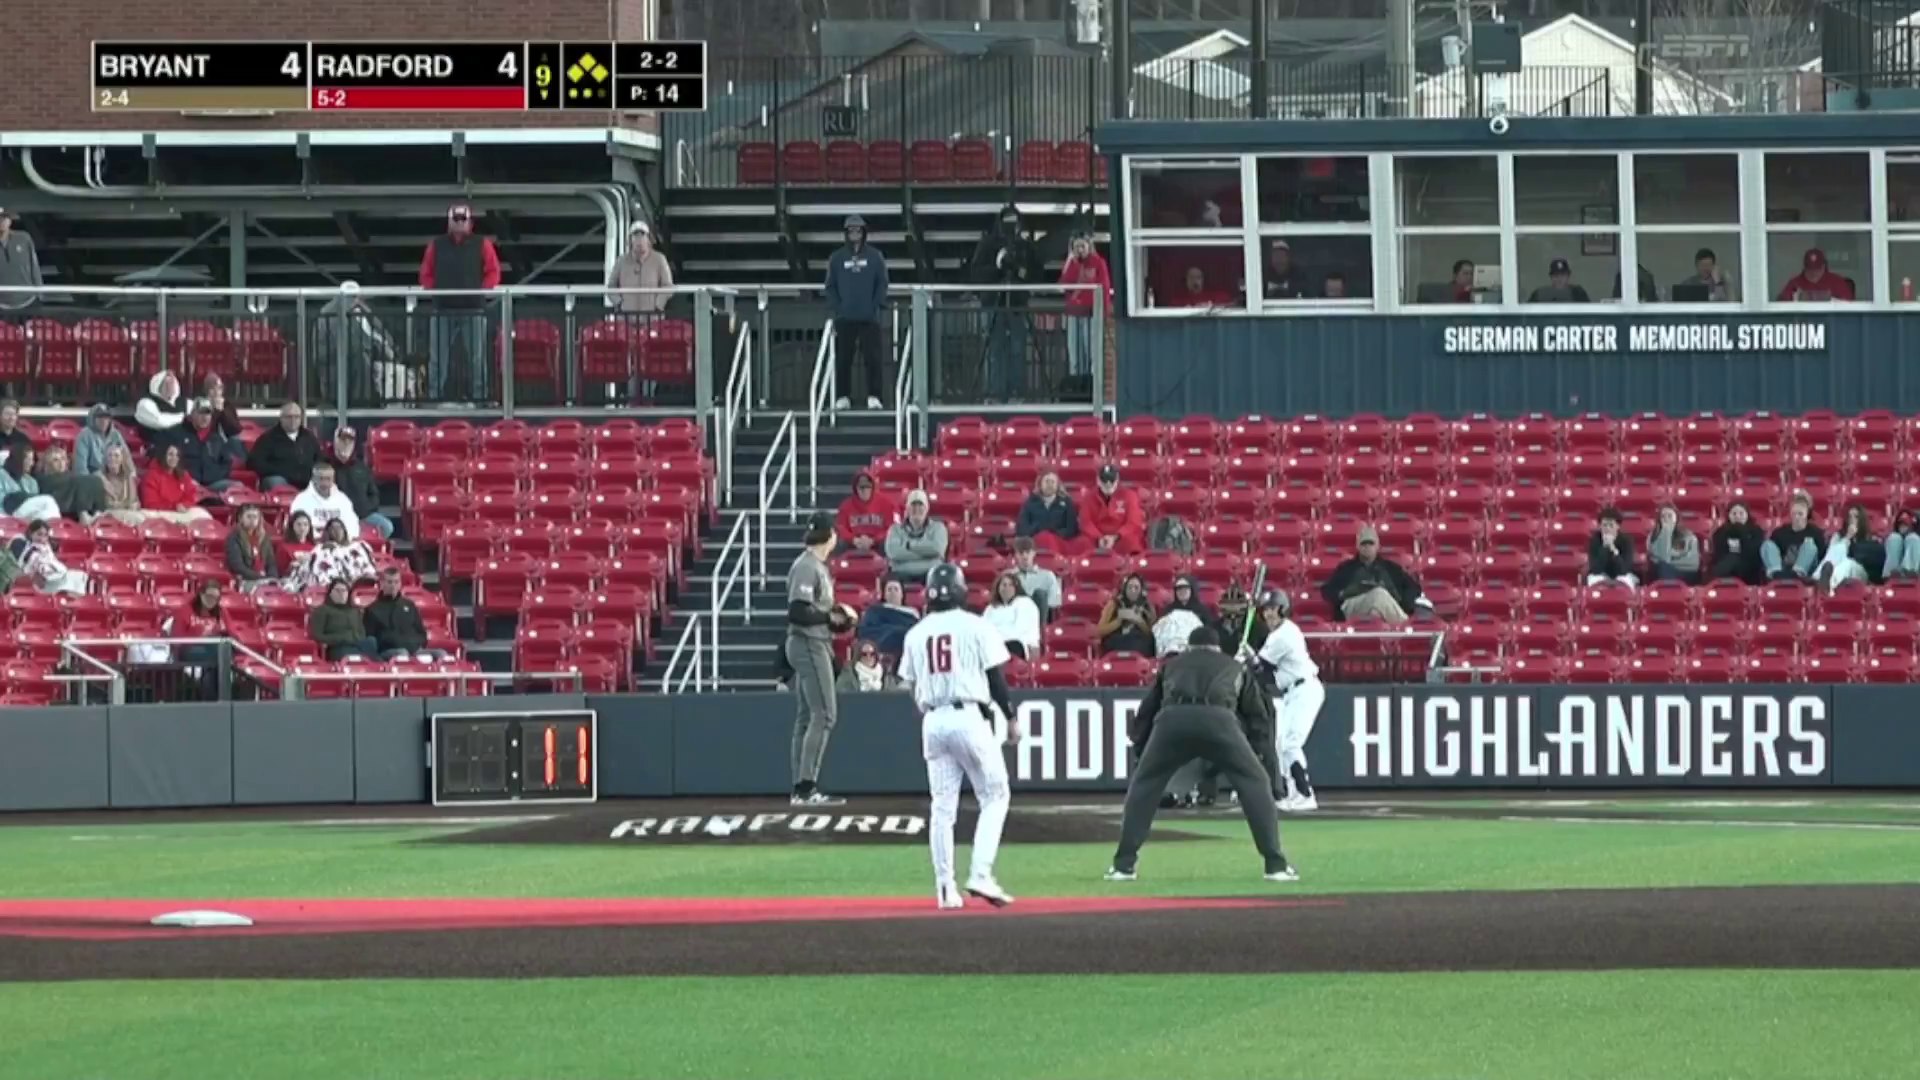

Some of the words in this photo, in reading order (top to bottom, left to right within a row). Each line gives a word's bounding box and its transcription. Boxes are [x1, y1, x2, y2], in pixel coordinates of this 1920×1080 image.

[824, 111, 855, 132] RU
[1443, 325, 1539, 353] SHERMAN
[1543, 325, 1618, 352] CARTER
[1629, 324, 1734, 352] MEMORIAL
[1737, 323, 1825, 350] STADIUM
[926, 633, 952, 675] 16
[544, 726, 590, 785] 11
[1350, 695, 1826, 777] HIGHLANDERS
